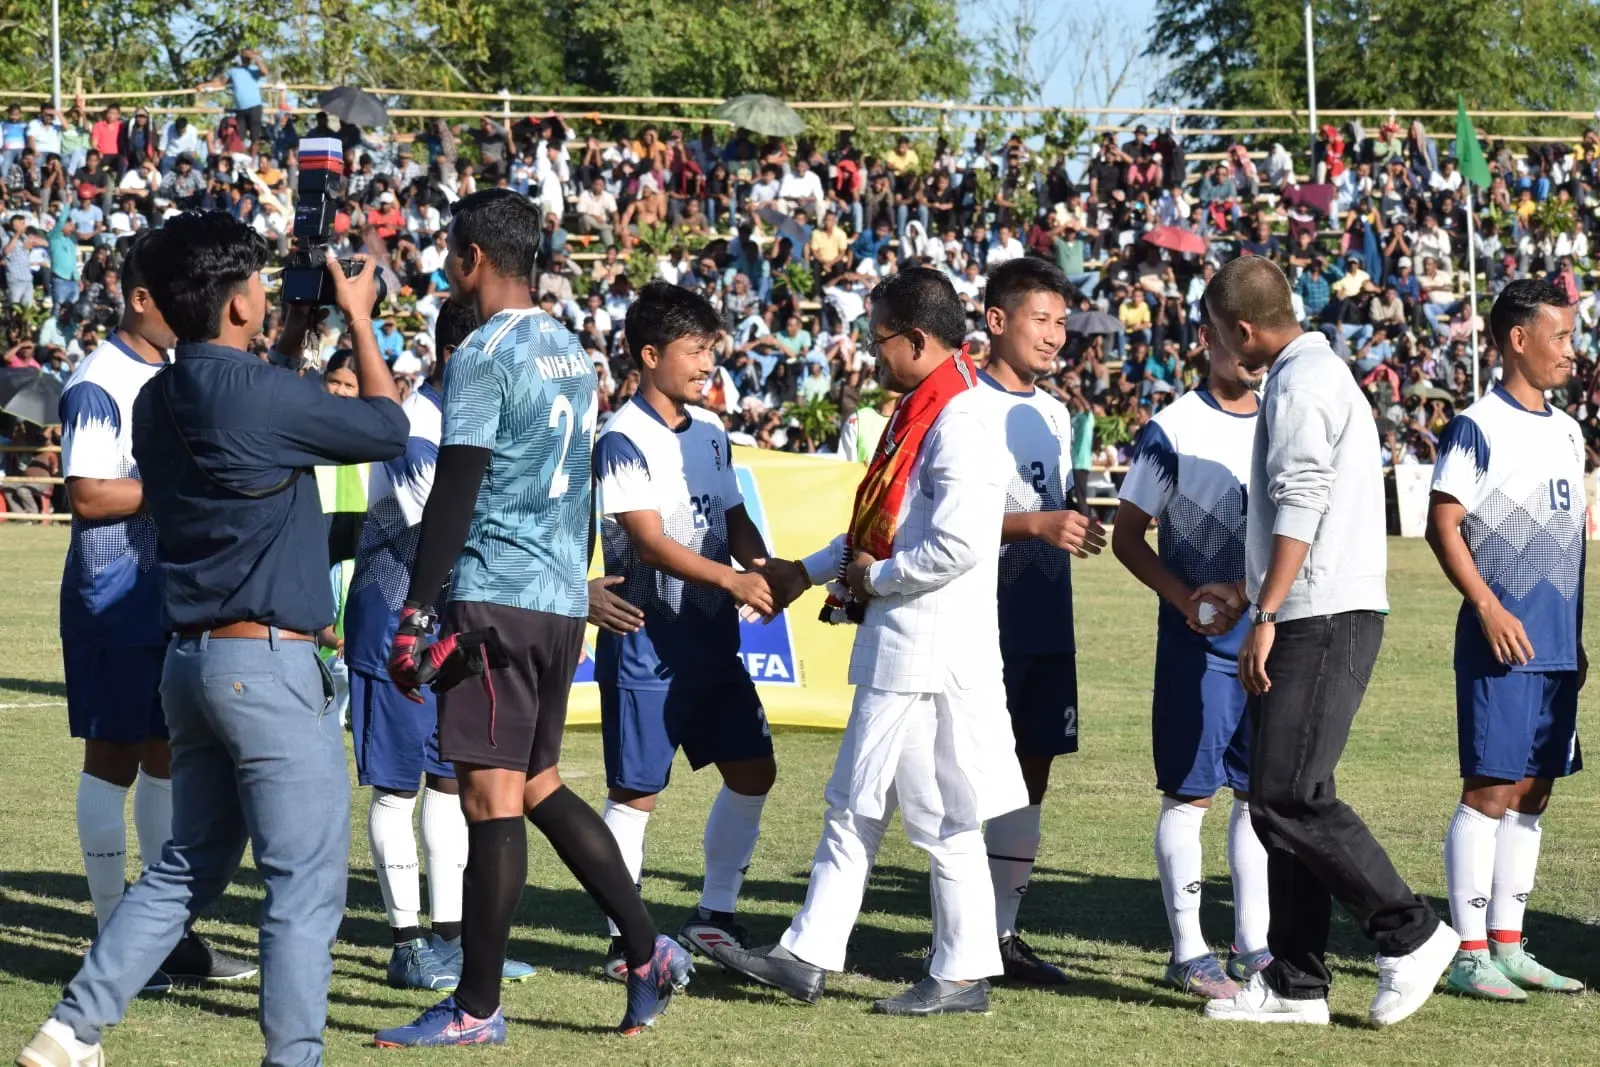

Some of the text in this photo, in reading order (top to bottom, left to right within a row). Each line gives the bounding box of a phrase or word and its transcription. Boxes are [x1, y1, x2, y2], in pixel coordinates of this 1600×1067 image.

[1549, 478, 1570, 511] 19
[737, 652, 790, 679] FA
[1064, 705, 1077, 737] 2
